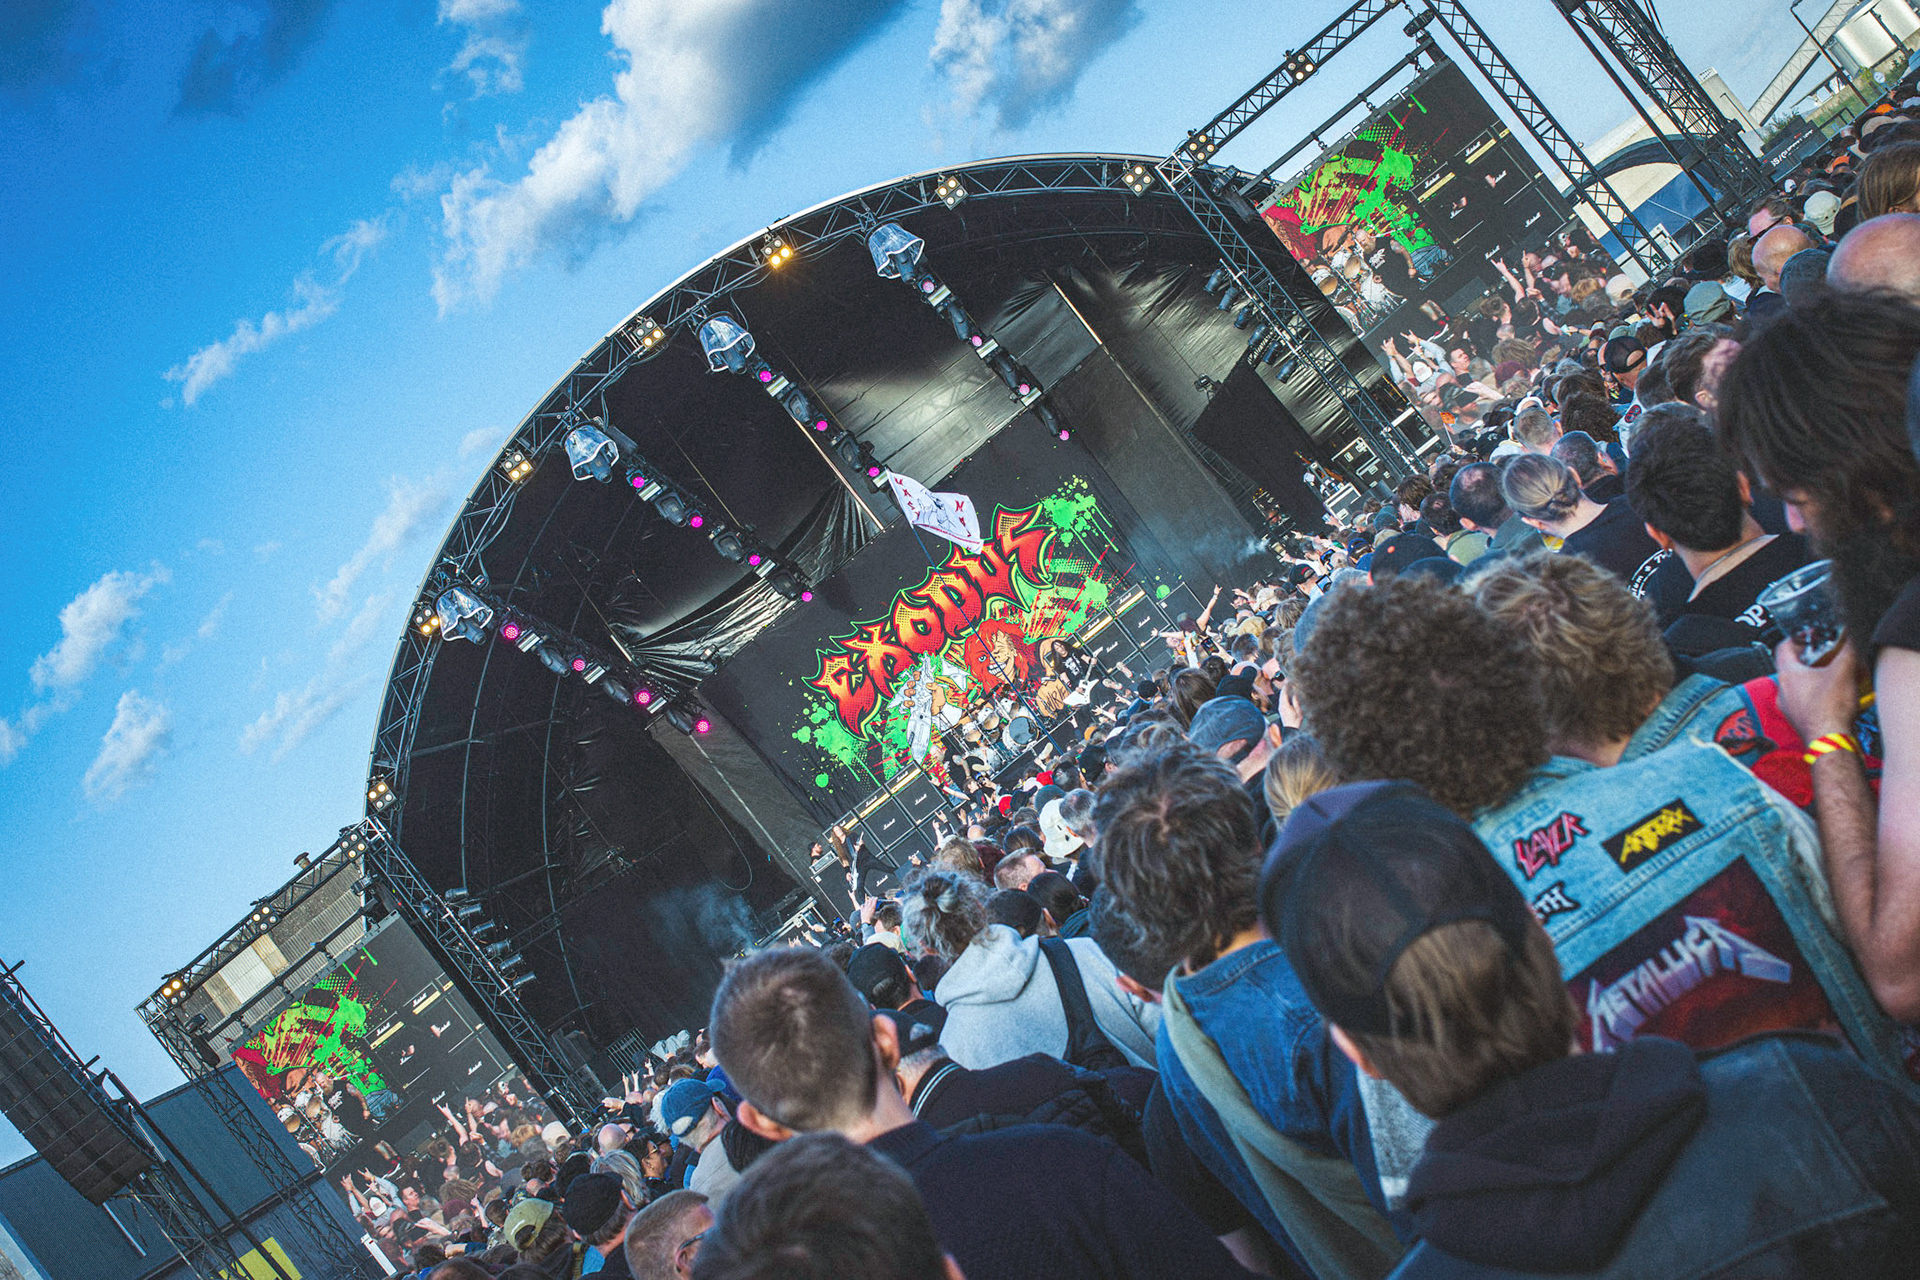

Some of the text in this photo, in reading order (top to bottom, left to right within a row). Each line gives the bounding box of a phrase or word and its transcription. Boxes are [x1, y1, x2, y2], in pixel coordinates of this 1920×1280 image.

[806, 505, 1056, 739] EXODUS
[1513, 811, 1590, 880] SLAYER
[1586, 915, 1792, 1055] METALLICA
